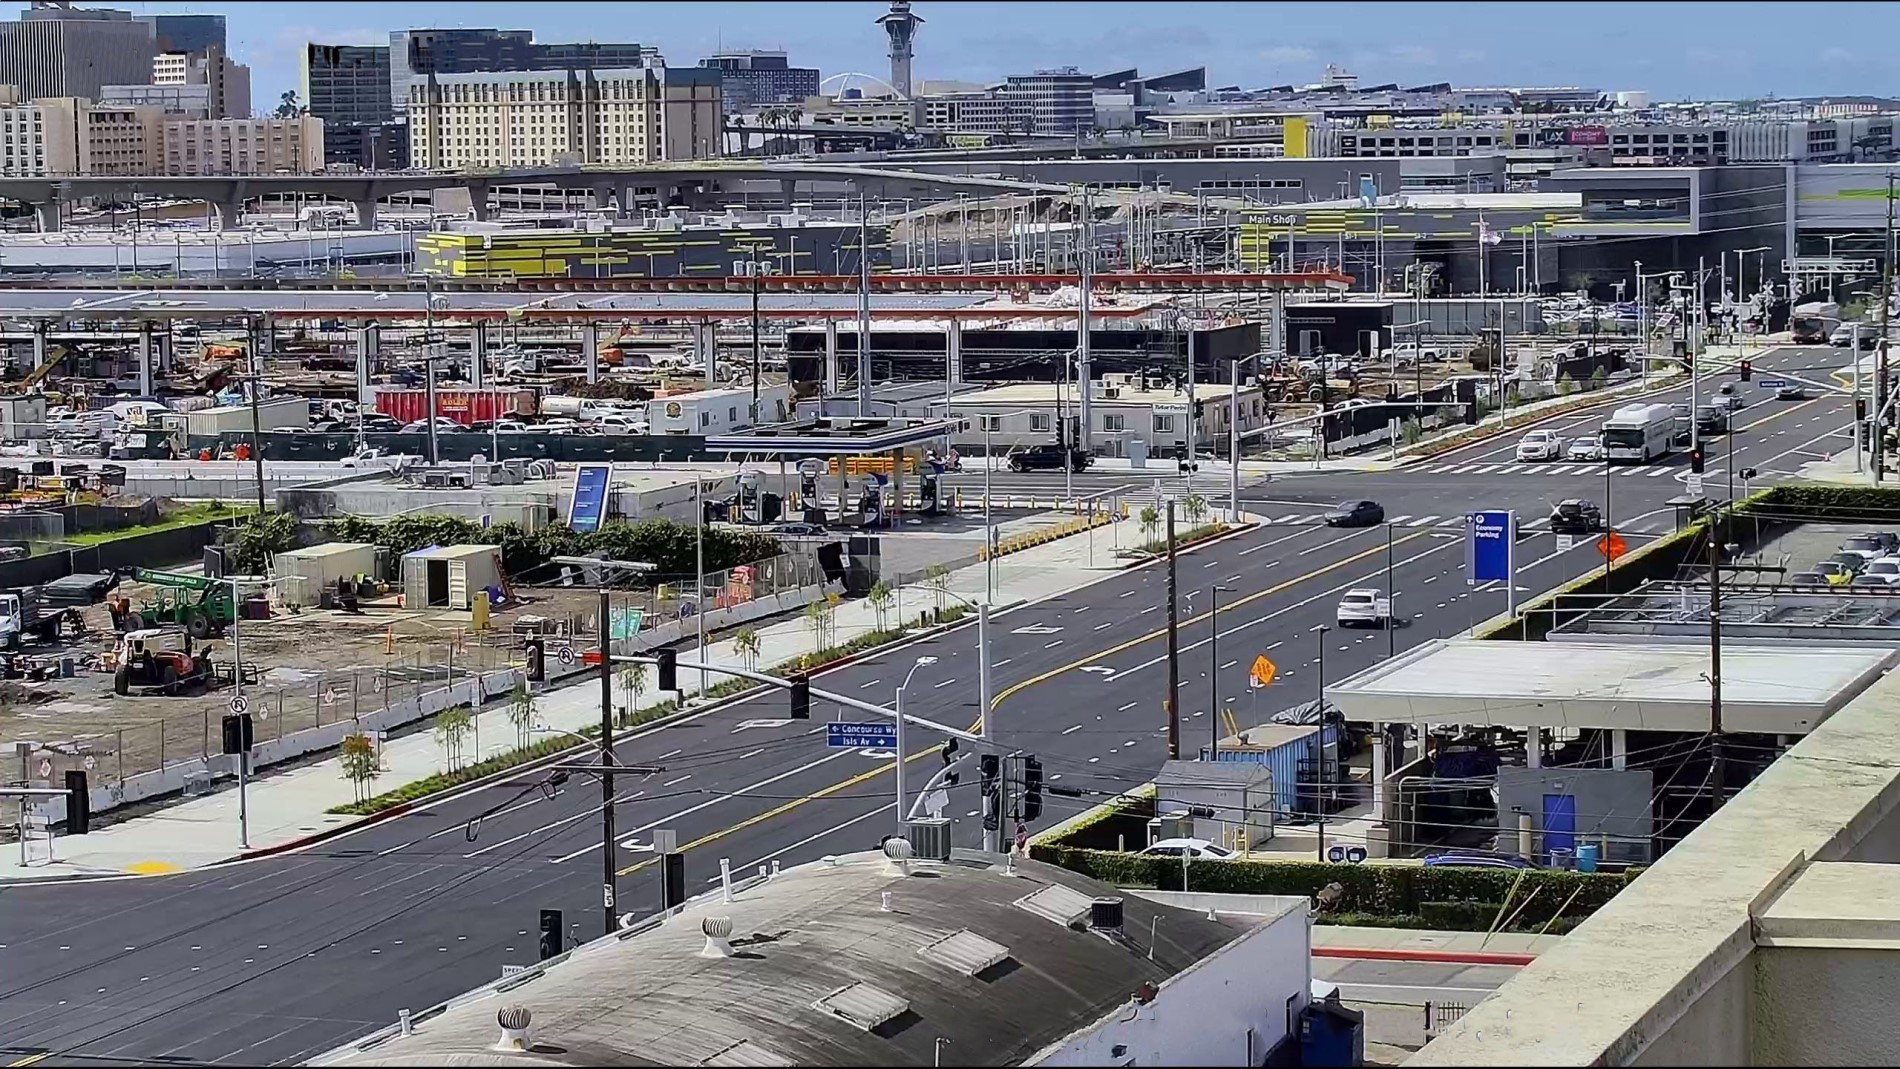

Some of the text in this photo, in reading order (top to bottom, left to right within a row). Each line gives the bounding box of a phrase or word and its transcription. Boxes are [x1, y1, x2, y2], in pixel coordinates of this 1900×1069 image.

[1545, 131, 1564, 142] LAX
[1248, 215, 1297, 225] Main Shop
[1475, 524, 1503, 532] Economy
[1475, 531, 1500, 539] Parking
[841, 725, 883, 734] Concourse
[843, 737, 858, 745] Isis
